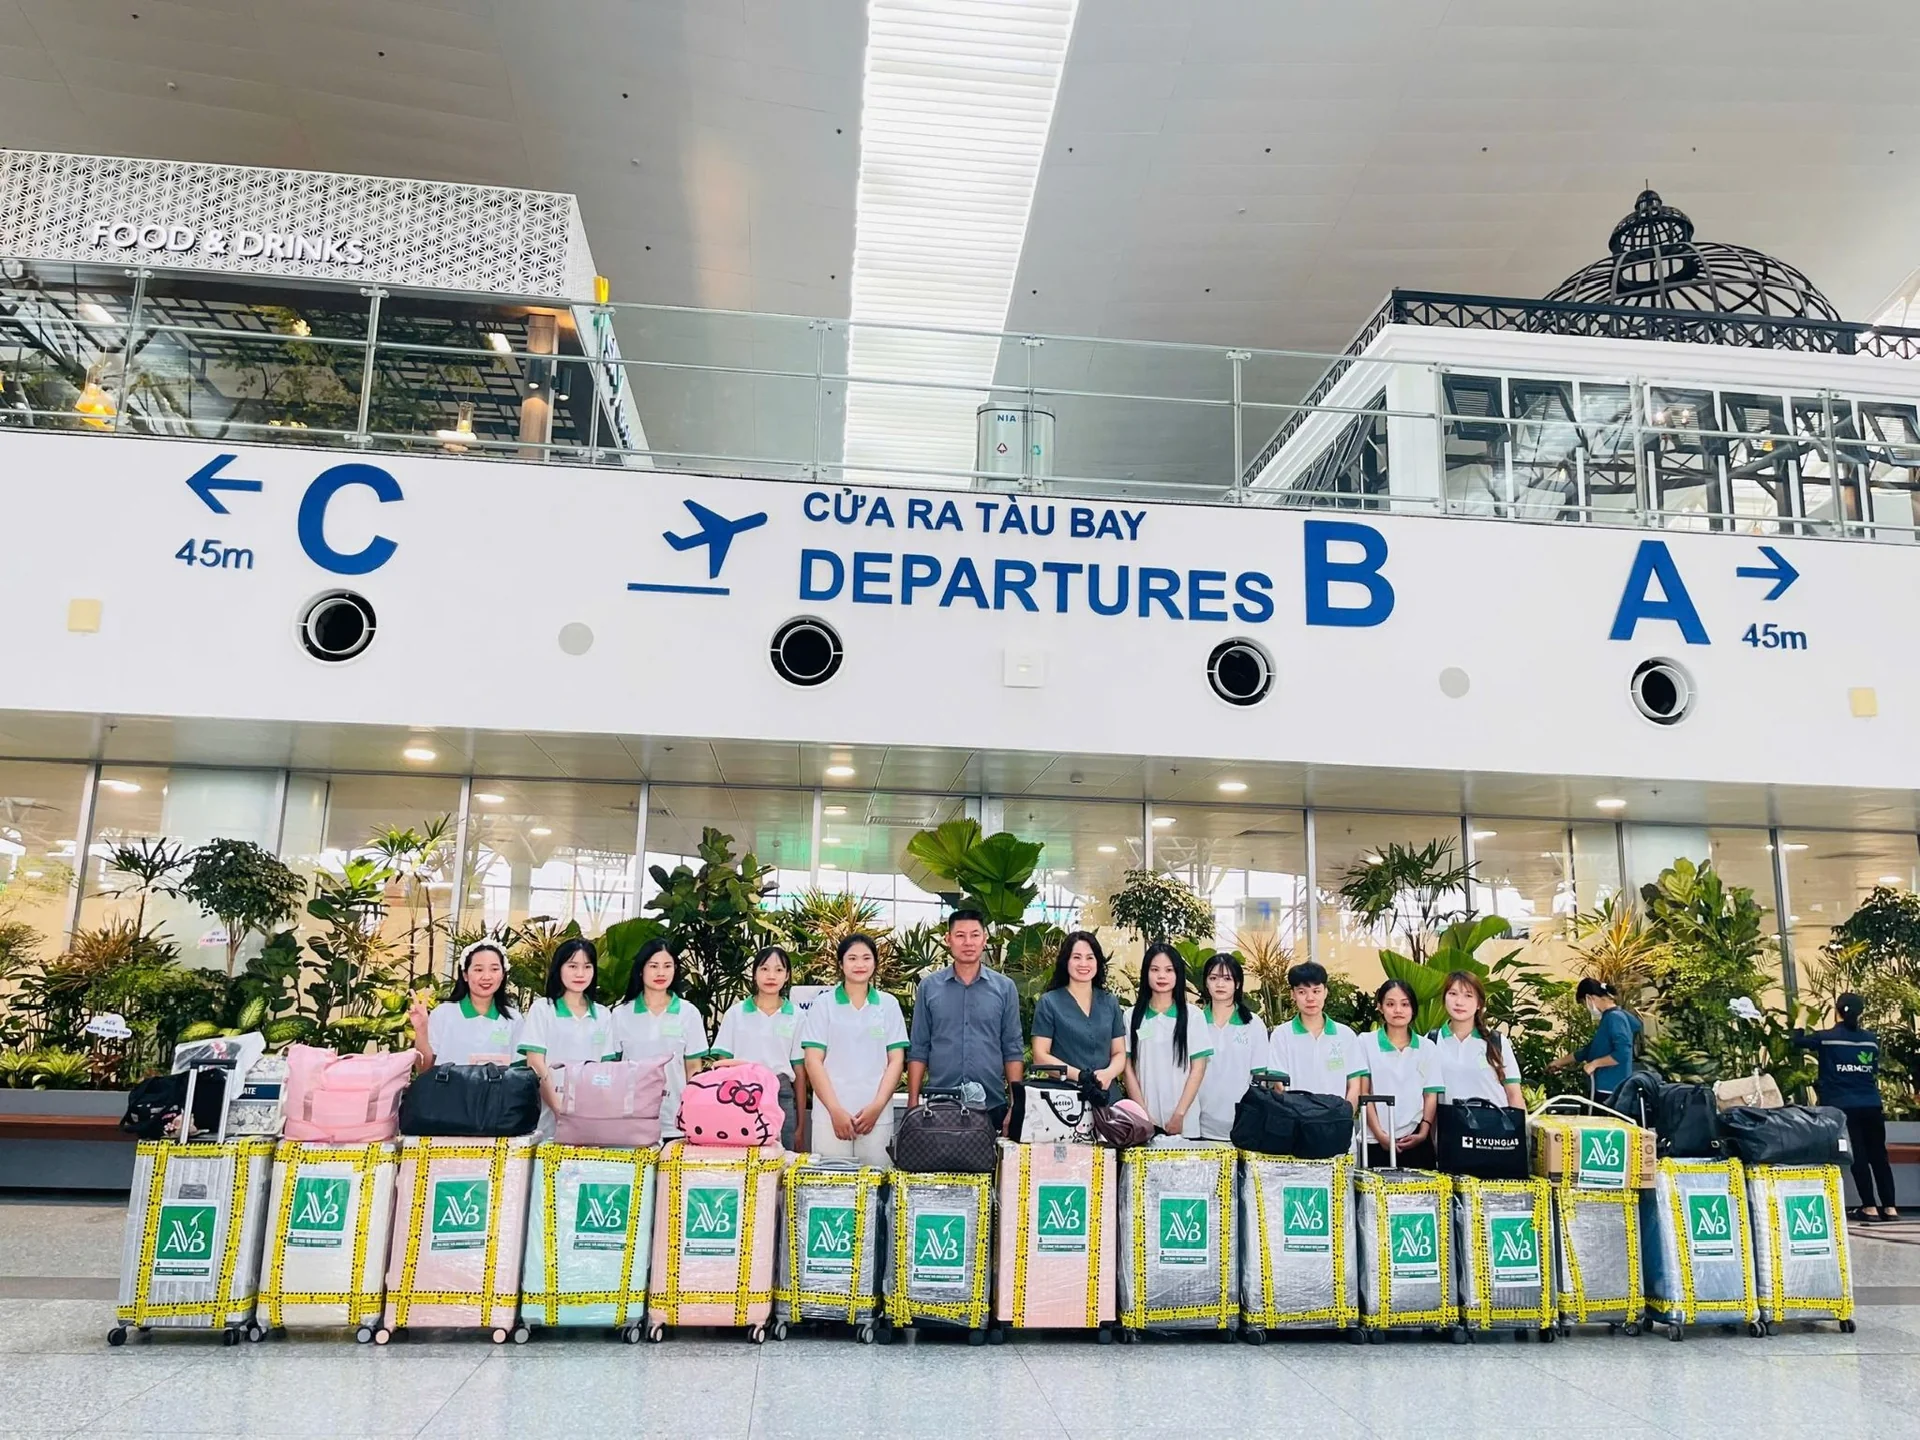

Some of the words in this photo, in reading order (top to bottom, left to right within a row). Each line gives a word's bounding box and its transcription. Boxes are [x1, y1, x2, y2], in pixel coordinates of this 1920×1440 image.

[91, 220, 196, 252] FOOD
[204, 229, 229, 255] &
[237, 231, 366, 266] DRINKS
[996, 414, 1017, 422] NIA
[298, 463, 404, 576] C
[803, 487, 895, 528] CỬA
[906, 497, 964, 533] RA
[975, 495, 1056, 537] TÀU
[1070, 507, 1148, 542] BAY
[175, 539, 255, 570] 45m
[1303, 519, 1395, 627] B
[799, 548, 1275, 624] DEPARTURES
[1609, 539, 1711, 646] A
[1742, 624, 1809, 650] 45m
[1585, 1131, 1620, 1166] AVB
[296, 1182, 340, 1225] AVB
[438, 1182, 480, 1226] AVB
[581, 1186, 621, 1228] AVB
[692, 1193, 731, 1232] AVB
[1042, 1189, 1080, 1229] AVB
[1165, 1202, 1201, 1242] AVB
[1288, 1190, 1324, 1230] AVB
[1695, 1197, 1728, 1235] AVB
[1793, 1197, 1824, 1235] AVB
[162, 1209, 206, 1253] AVB
[812, 1211, 851, 1252] AVB
[919, 1218, 959, 1260] AVB
[1396, 1217, 1433, 1257] AVB
[1498, 1220, 1532, 1261] AVB
